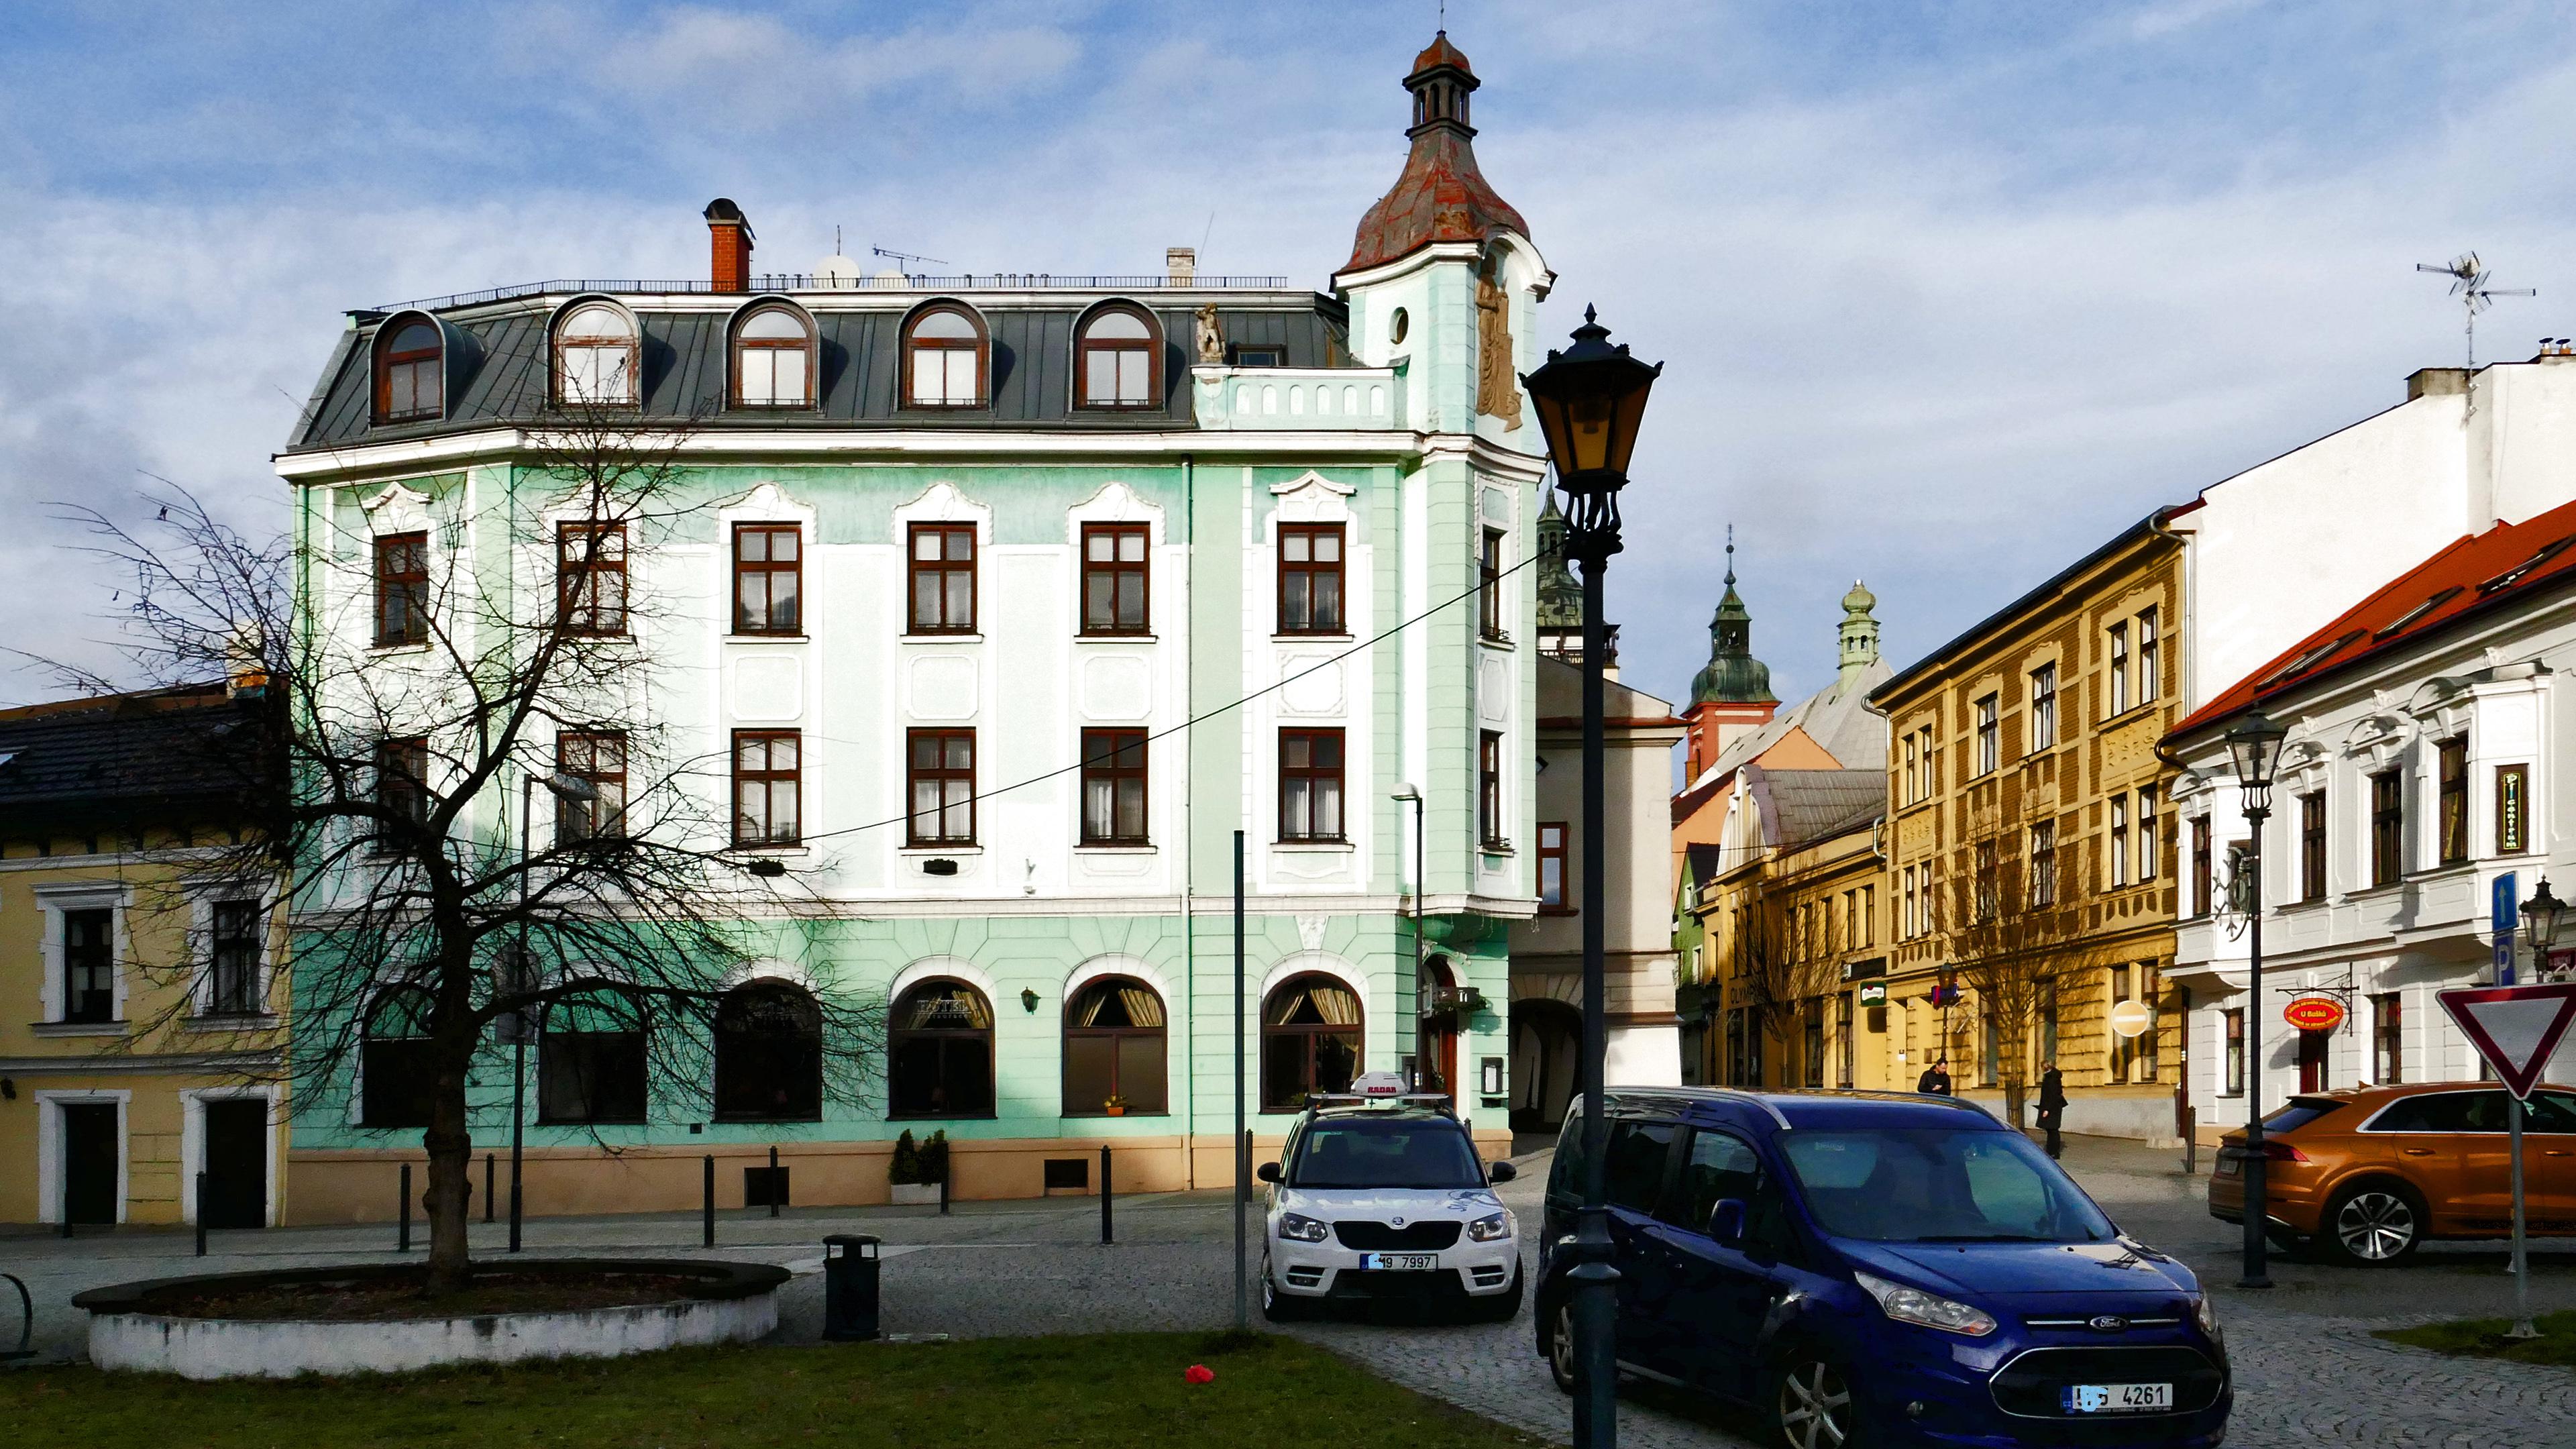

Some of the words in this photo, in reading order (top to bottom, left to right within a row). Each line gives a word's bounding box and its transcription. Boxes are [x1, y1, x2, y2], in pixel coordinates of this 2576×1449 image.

[2498, 945, 2510, 985] P
[916, 1000, 969, 1012] HOTEL
[1402, 1256, 1431, 1268] 7997
[2100, 1318, 2121, 1327] Ford
[2123, 1385, 2164, 1405] 4261
